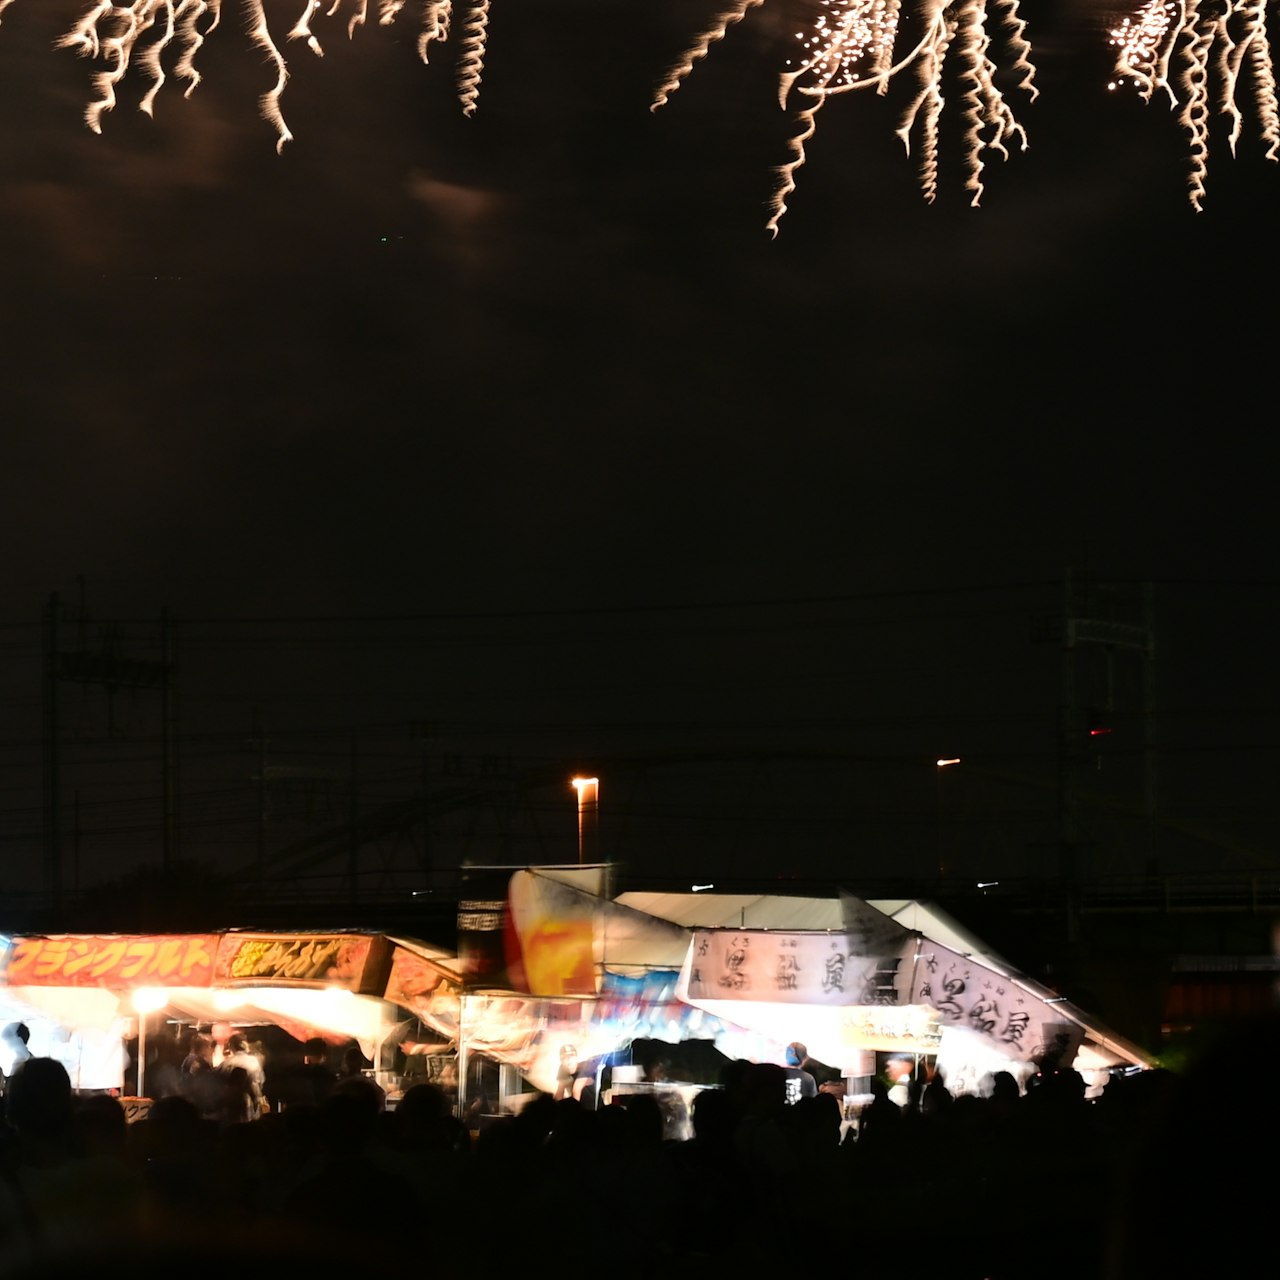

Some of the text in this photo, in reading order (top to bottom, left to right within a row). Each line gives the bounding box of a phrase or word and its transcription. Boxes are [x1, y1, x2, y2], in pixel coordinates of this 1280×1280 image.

[8, 939, 210, 978] フランクフルト
